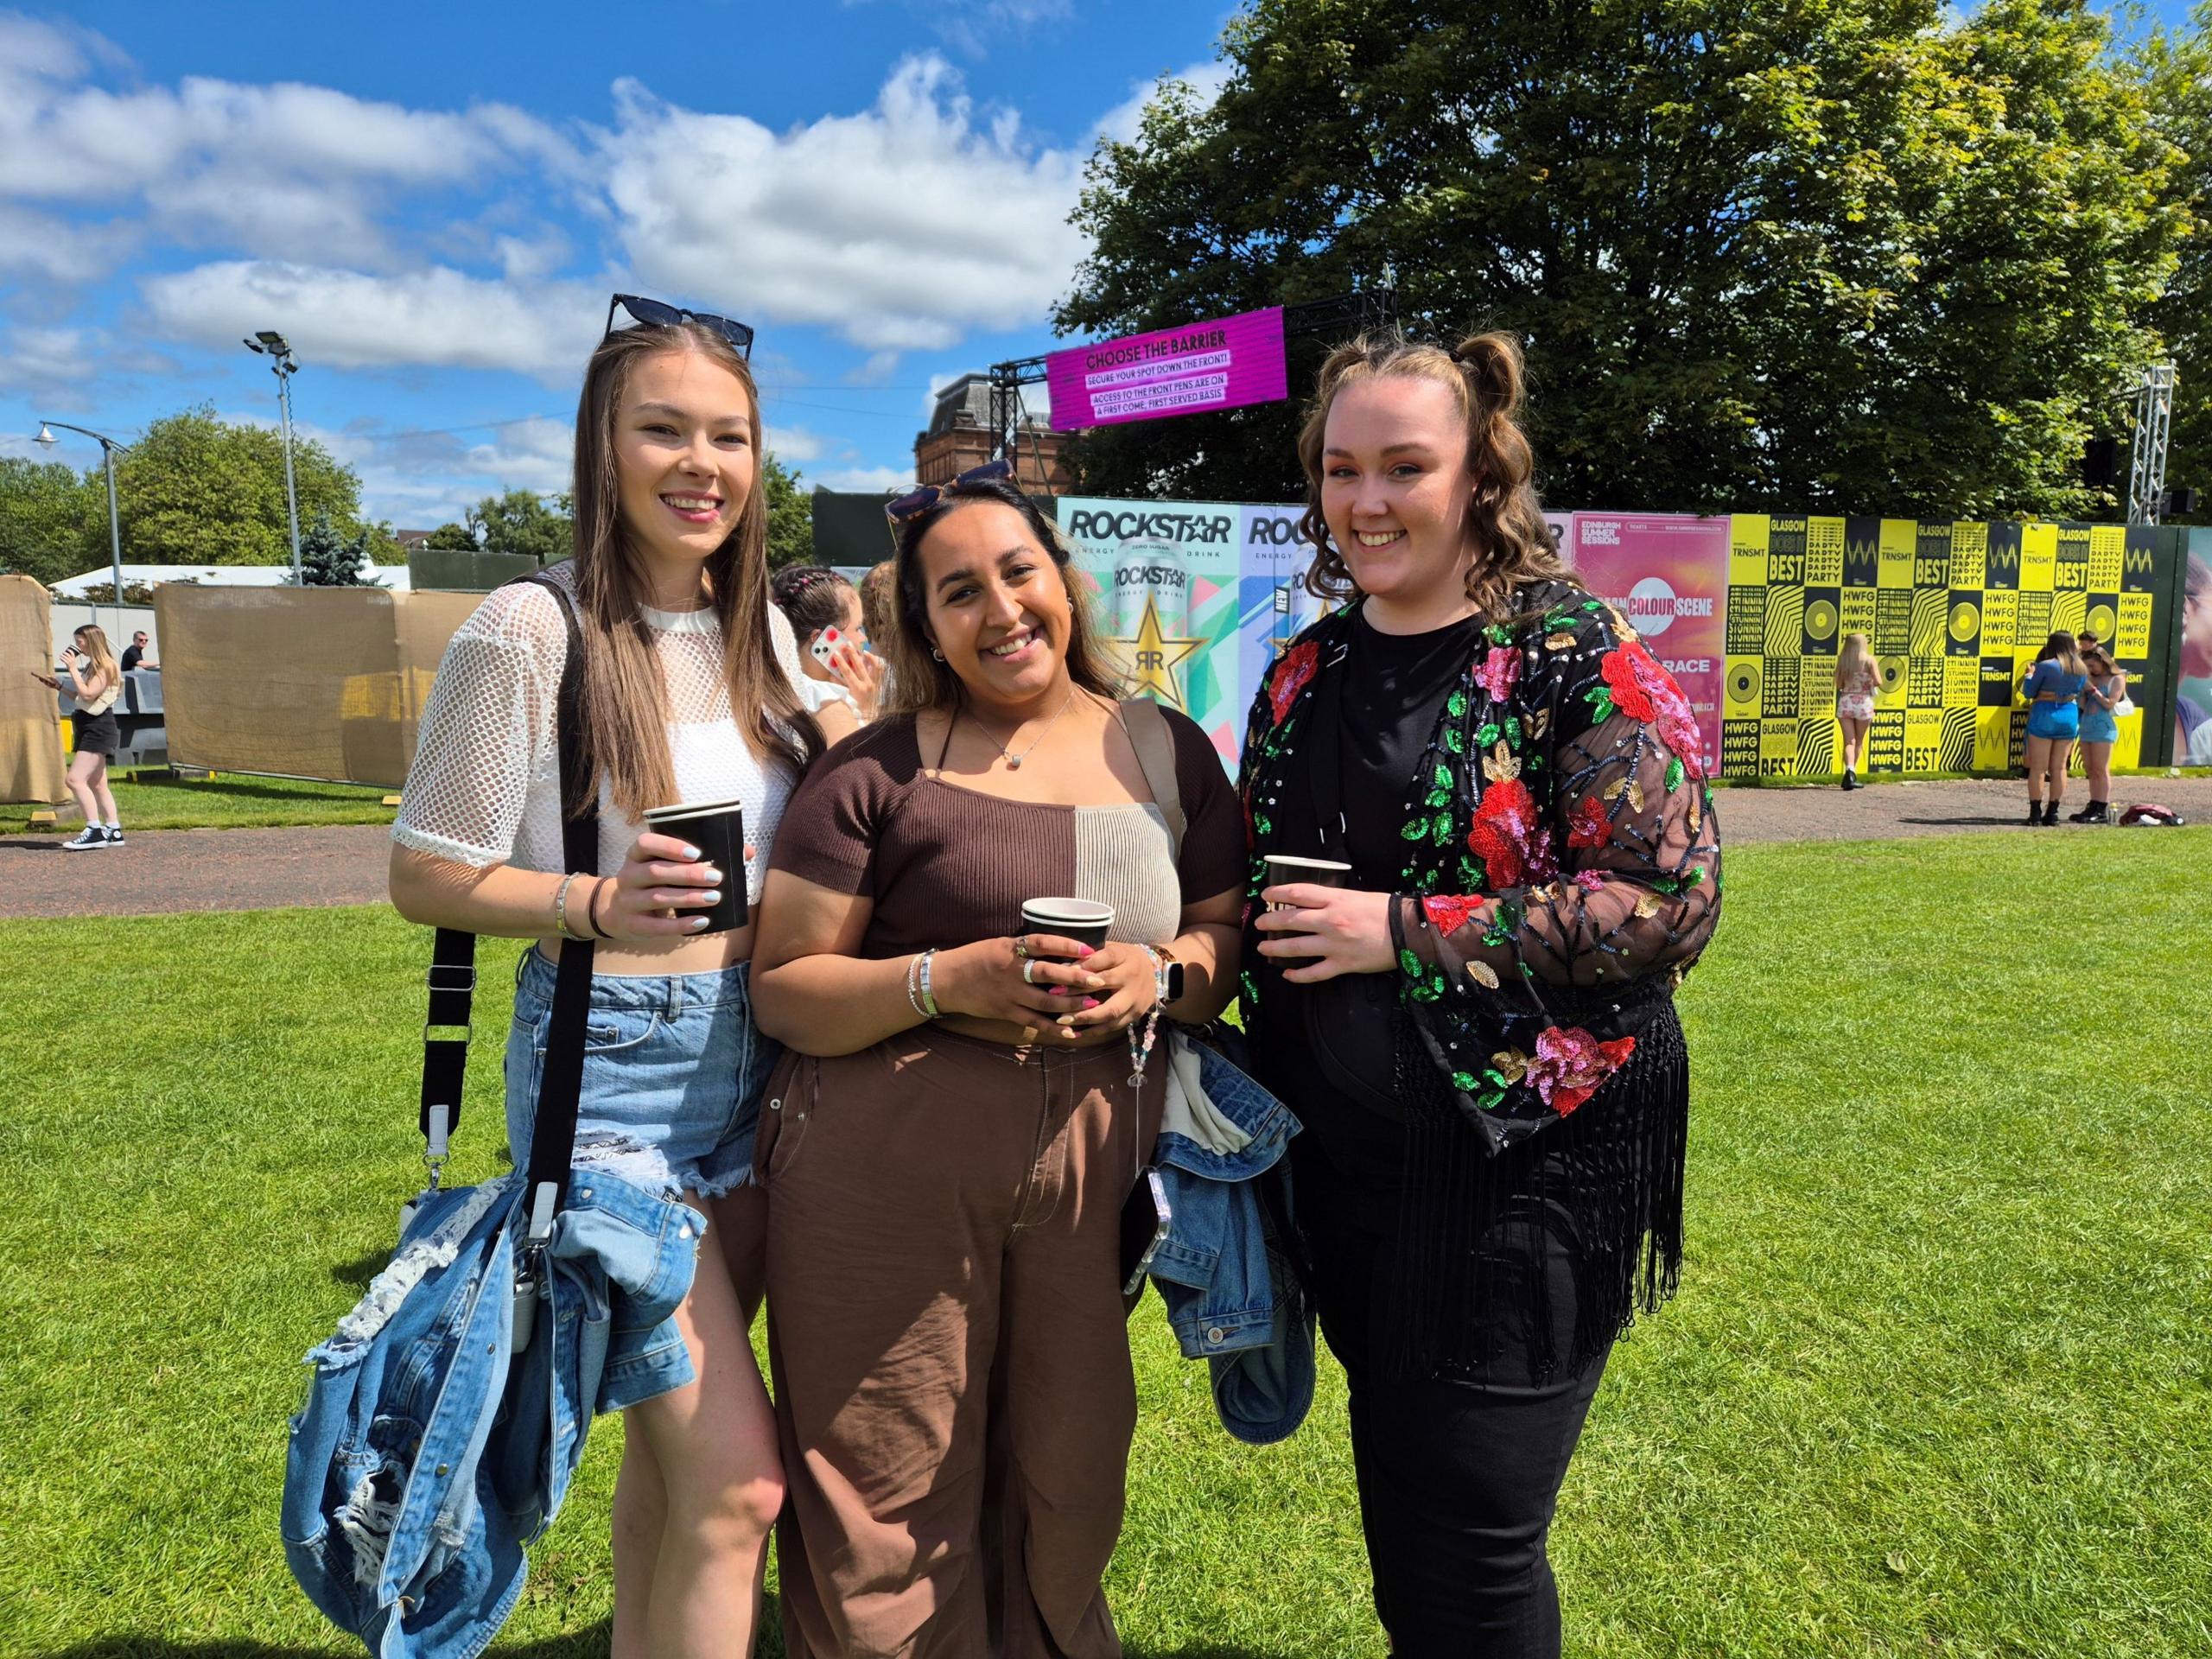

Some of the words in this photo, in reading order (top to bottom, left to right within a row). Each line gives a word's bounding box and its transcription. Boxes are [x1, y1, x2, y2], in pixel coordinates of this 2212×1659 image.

[1086, 346, 1141, 369] CHOOSE
[1143, 340, 1168, 359] THE
[1171, 330, 1226, 353] BARRIER
[1088, 373, 1115, 385] SECURE
[1116, 369, 1135, 380] YOUR
[1137, 365, 1155, 377] SPOT
[1157, 361, 1181, 374] DOWN
[1183, 358, 1198, 370] THE
[1198, 353, 1227, 367] FRONT!
[1094, 391, 1122, 404] ACCESS
[1122, 390, 1133, 399] TO
[1134, 386, 1147, 397] THE
[1148, 383, 1173, 396] FRONT
[1174, 380, 1193, 391] PENS
[1194, 376, 1210, 388] ARE
[1211, 374, 1224, 385] ON
[1097, 407, 1103, 416] A
[1103, 402, 1122, 415] FIRST
[1122, 398, 1147, 412] COME,
[1148, 395, 1167, 408] FIRST
[1168, 391, 1198, 405] SERVED
[1199, 388, 1223, 400] BASIS
[1069, 510, 1231, 543] ROCKSTAR
[1581, 520, 1621, 530] EDINBURGH
[1770, 519, 1806, 532] GLASGOW
[1917, 524, 1951, 537] GLASGOW
[1581, 529, 1615, 537] SUMMER
[2058, 529, 2091, 542] GLASGOW
[1581, 536, 1620, 545] SESSIONS
[1733, 548, 1765, 557] TRNSMT
[1882, 552, 1912, 561] TRNSMT
[2024, 556, 2052, 564] TRNSMT
[1769, 554, 1805, 582] BEST
[1916, 558, 1949, 584] BEST
[1114, 566, 1185, 590] ROCKSTAR
[1807, 572, 1840, 582] PARTY
[1950, 575, 1982, 585] PARTY
[2055, 562, 2088, 588] BEST
[2089, 579, 2119, 588] PARTY
[1274, 588, 1287, 611] NEW
[1843, 591, 1875, 601] HWFG
[1986, 594, 2015, 604] HWFG
[1628, 598, 1675, 616] COLOUR
[1676, 598, 1713, 616] SCENE
[2121, 597, 2149, 607] HWFG
[1842, 605, 1874, 616] HWFG
[1986, 607, 2014, 618] HWFG
[2120, 611, 2148, 620] HWFG
[1841, 620, 1873, 630] HWFG
[1984, 621, 2013, 632] HWFG
[2119, 624, 2146, 633] HWFG
[1983, 635, 2012, 645] HWFG
[2118, 638, 2145, 647] HWFG
[1662, 659, 1711, 672] RACE
[1981, 671, 2012, 682] TRNSMT
[2126, 674, 2143, 683] SMT
[1908, 695, 1941, 706] PARTY
[1763, 704, 1797, 715] PARTY
[1872, 712, 1904, 723] HWFG
[1907, 714, 1940, 724] GLASGOW
[2012, 715, 2028, 725] HW
[1725, 722, 1758, 734] HWFG
[1762, 723, 1796, 734] GLASGOW
[1871, 726, 1903, 737] HWFG
[1724, 736, 1758, 748] HWFG
[1871, 740, 1902, 751] HWFG
[1724, 751, 1757, 762] HWFG
[1870, 753, 1902, 765] HWFG
[1905, 747, 1937, 771] BEST
[1723, 765, 1757, 777] HWFG
[1762, 758, 1795, 776] BEST
